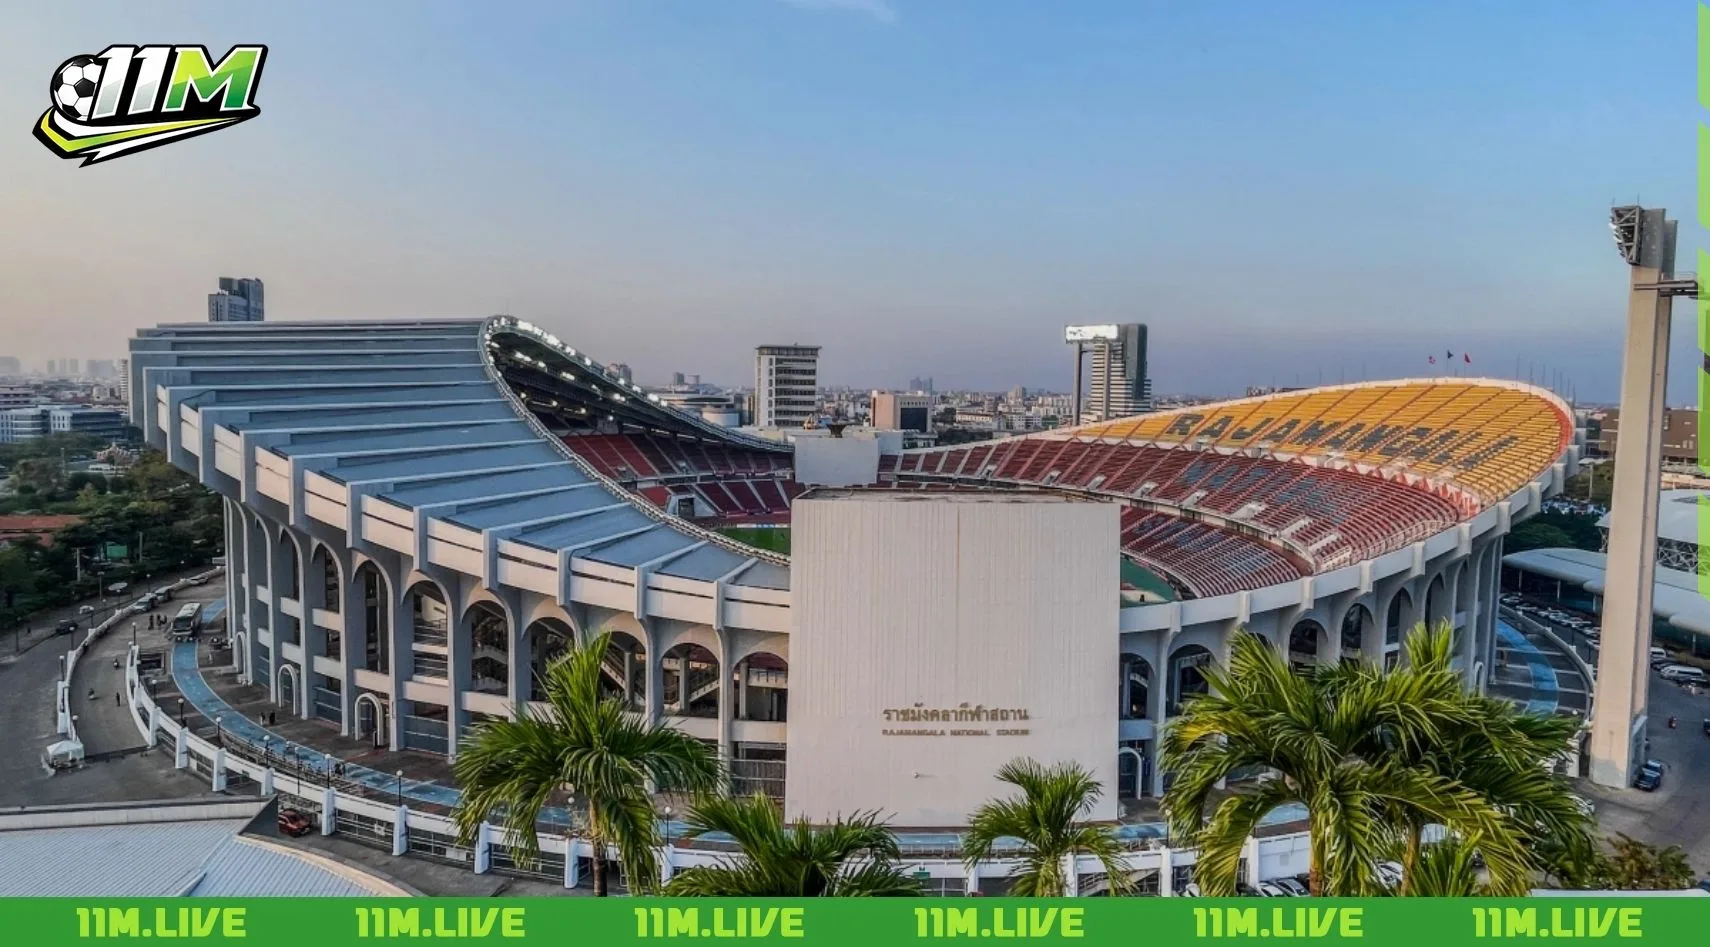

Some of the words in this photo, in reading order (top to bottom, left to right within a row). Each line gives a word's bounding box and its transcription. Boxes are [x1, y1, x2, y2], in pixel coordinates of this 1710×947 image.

[882, 702, 1030, 722] ราชมังคลากีฬาสถาน
